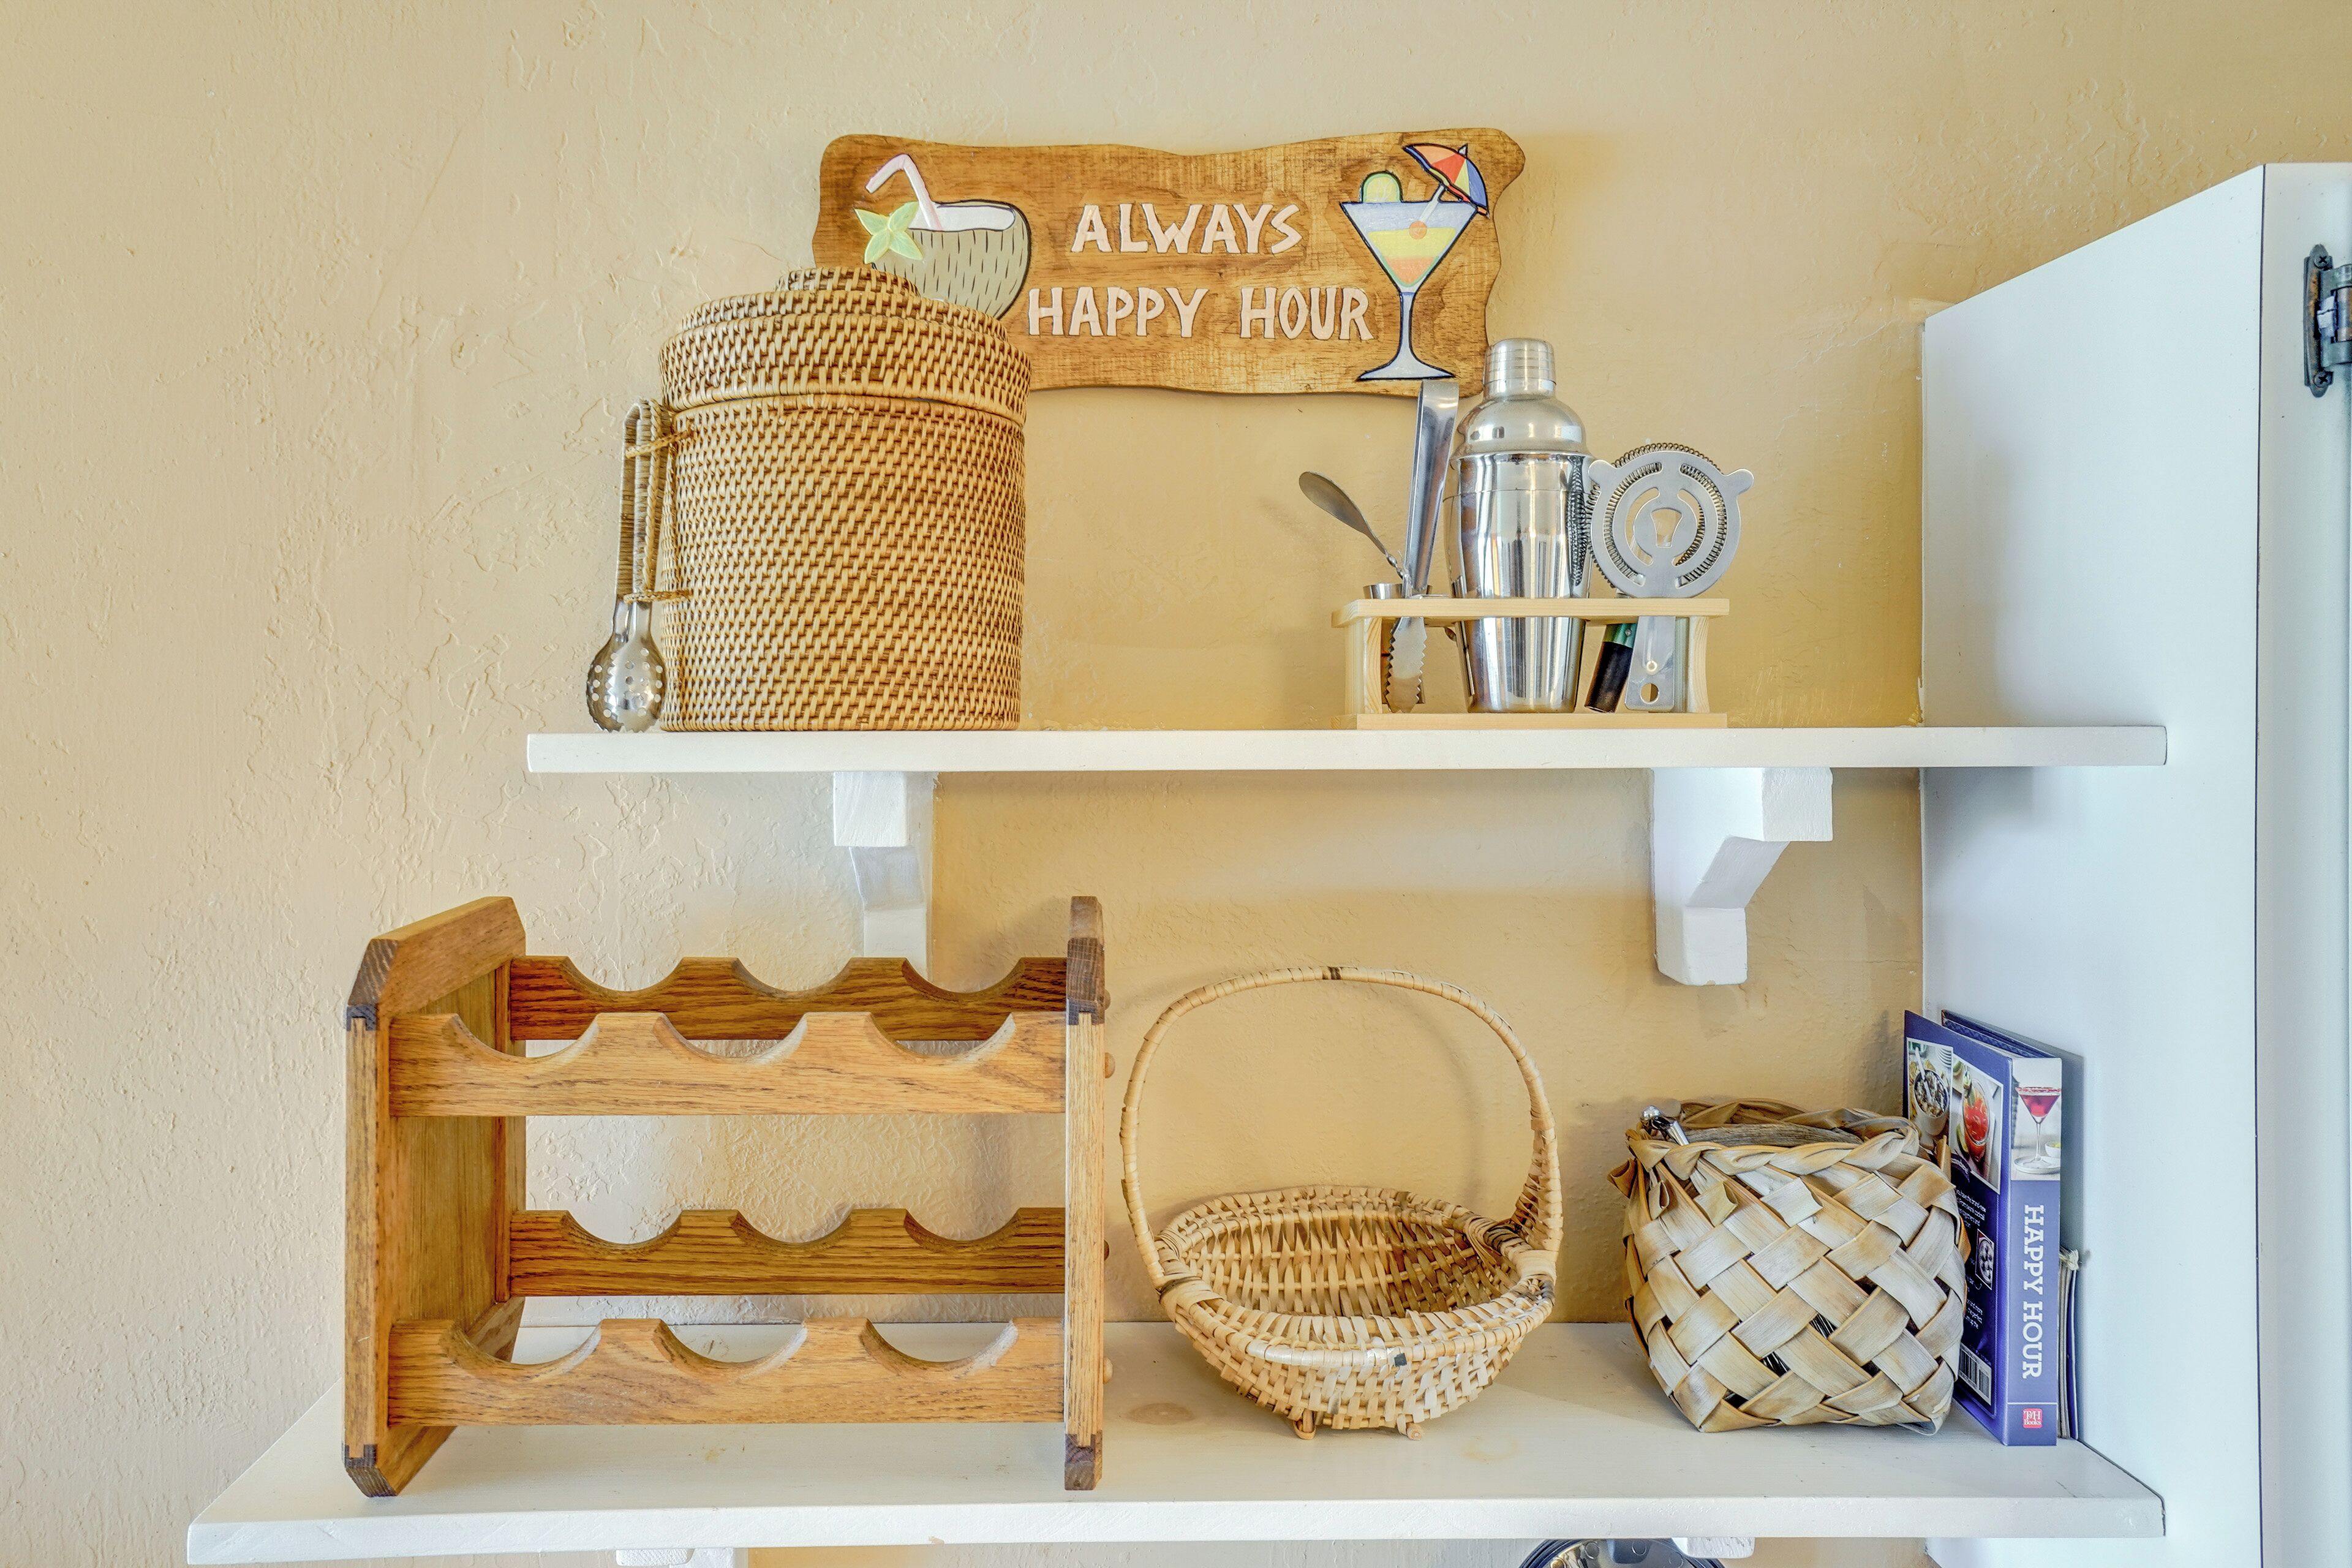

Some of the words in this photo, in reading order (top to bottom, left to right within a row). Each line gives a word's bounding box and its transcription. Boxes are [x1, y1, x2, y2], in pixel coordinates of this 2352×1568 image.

[1070, 203, 1302, 254] ALWAYS
[1027, 286, 1210, 338] HAPPY
[1239, 286, 1374, 340] HOUR
[2024, 1205, 2044, 1295] HAPPY
[2022, 1302, 2043, 1379] HOUR
